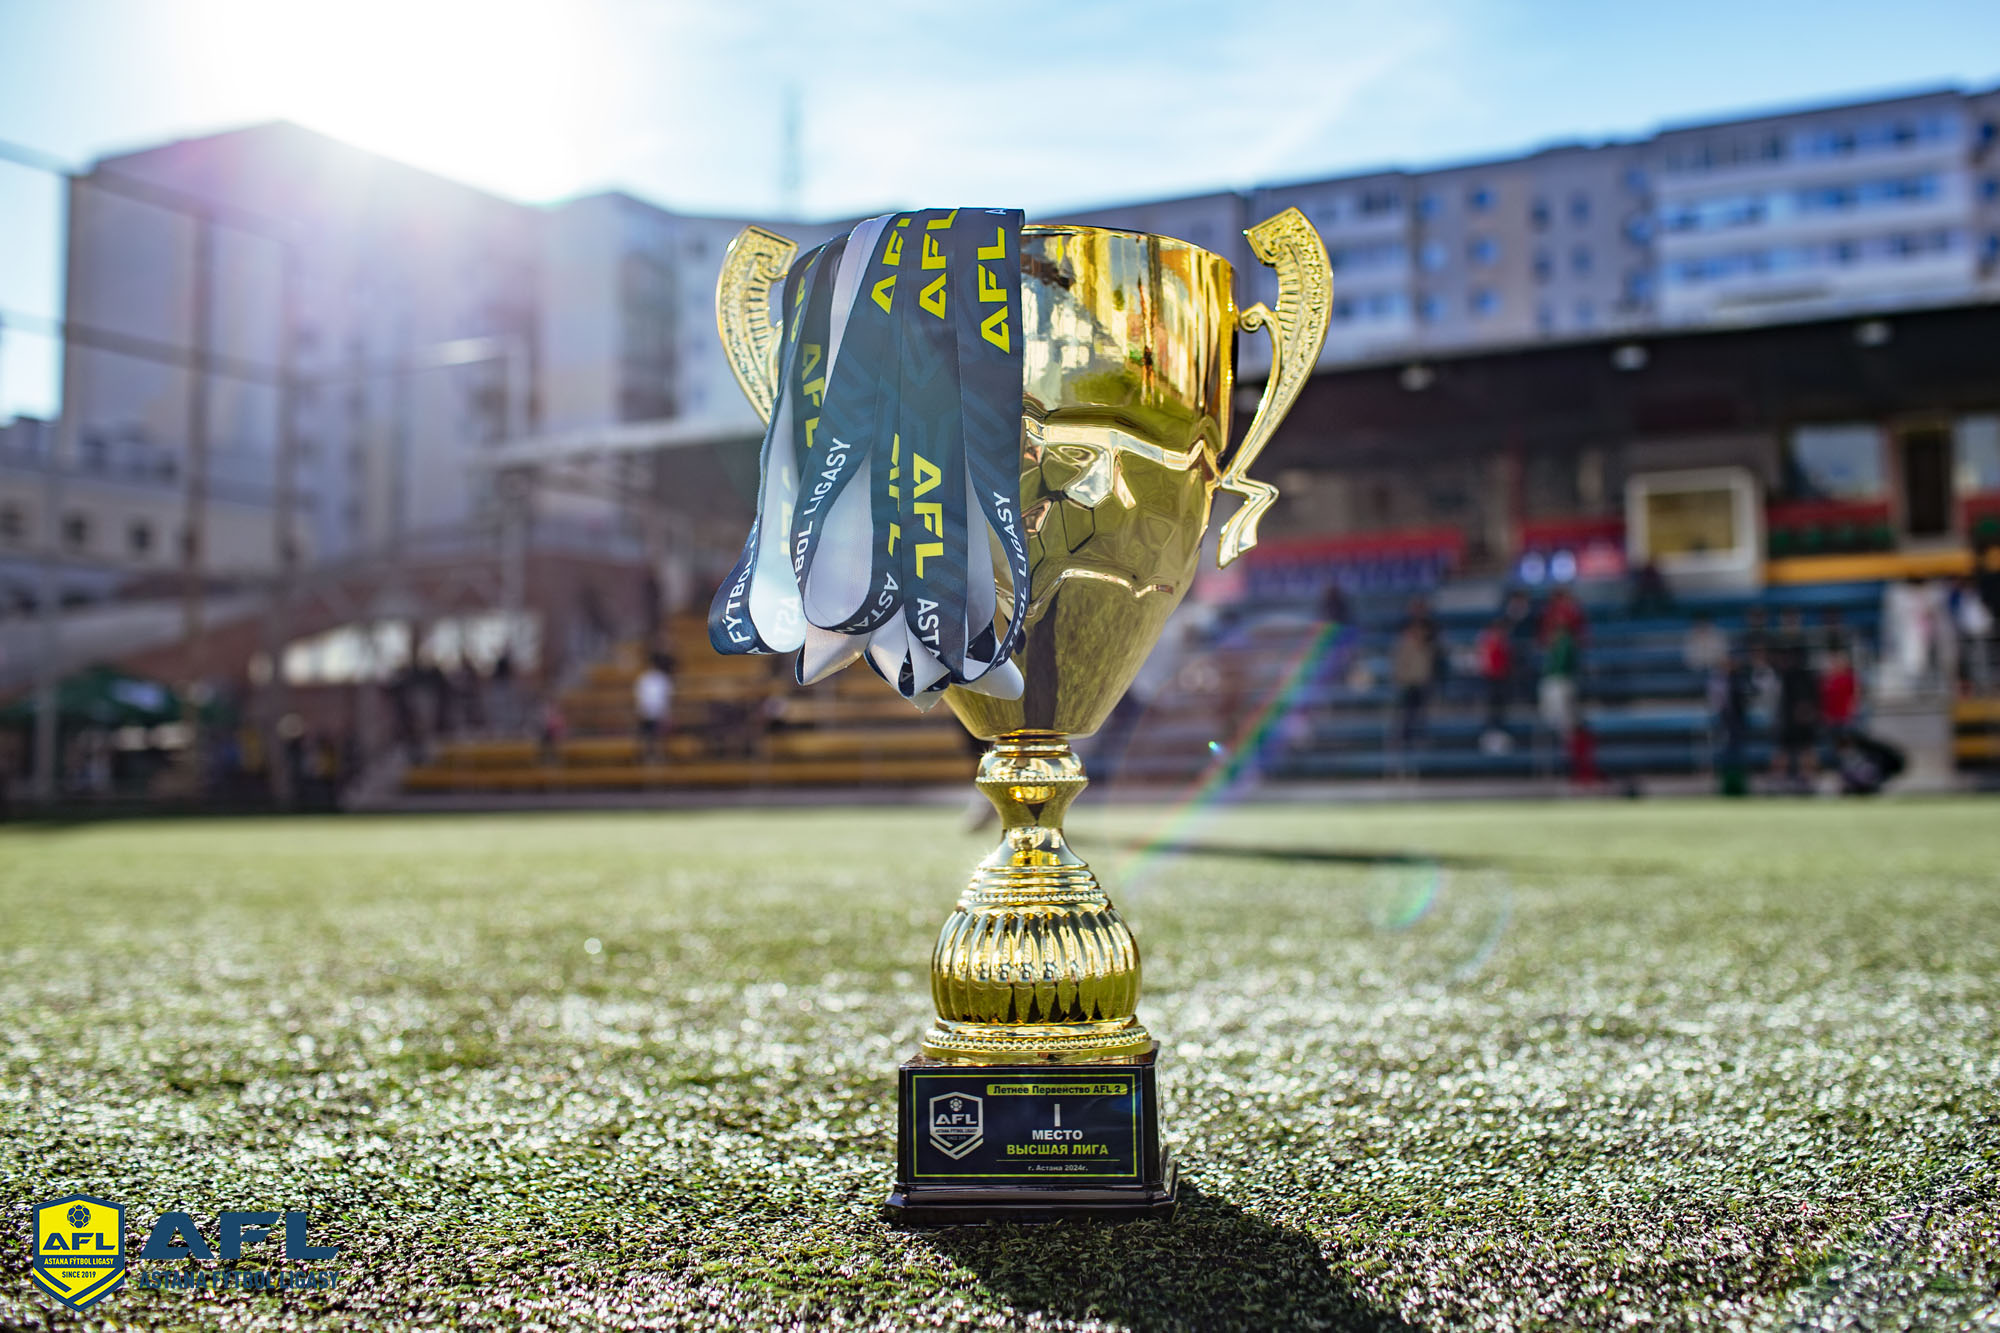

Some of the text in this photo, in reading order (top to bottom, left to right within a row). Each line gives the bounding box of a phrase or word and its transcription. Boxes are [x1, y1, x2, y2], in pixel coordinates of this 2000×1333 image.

[870, 218, 912, 315] AF
[977, 226, 1010, 354] AFL
[803, 437, 851, 516] LIGASY
[913, 452, 944, 579] AFL
[993, 491, 1027, 578] LIGASY
[935, 1113, 977, 1125] AFL
[993, 1086, 1029, 1094] Летнее
[1032, 1086, 1090, 1096] Первенство
[1006, 1144, 1109, 1155] ВЫСШАЯ ЛИГА
[1032, 1129, 1083, 1140] МЕСТО
